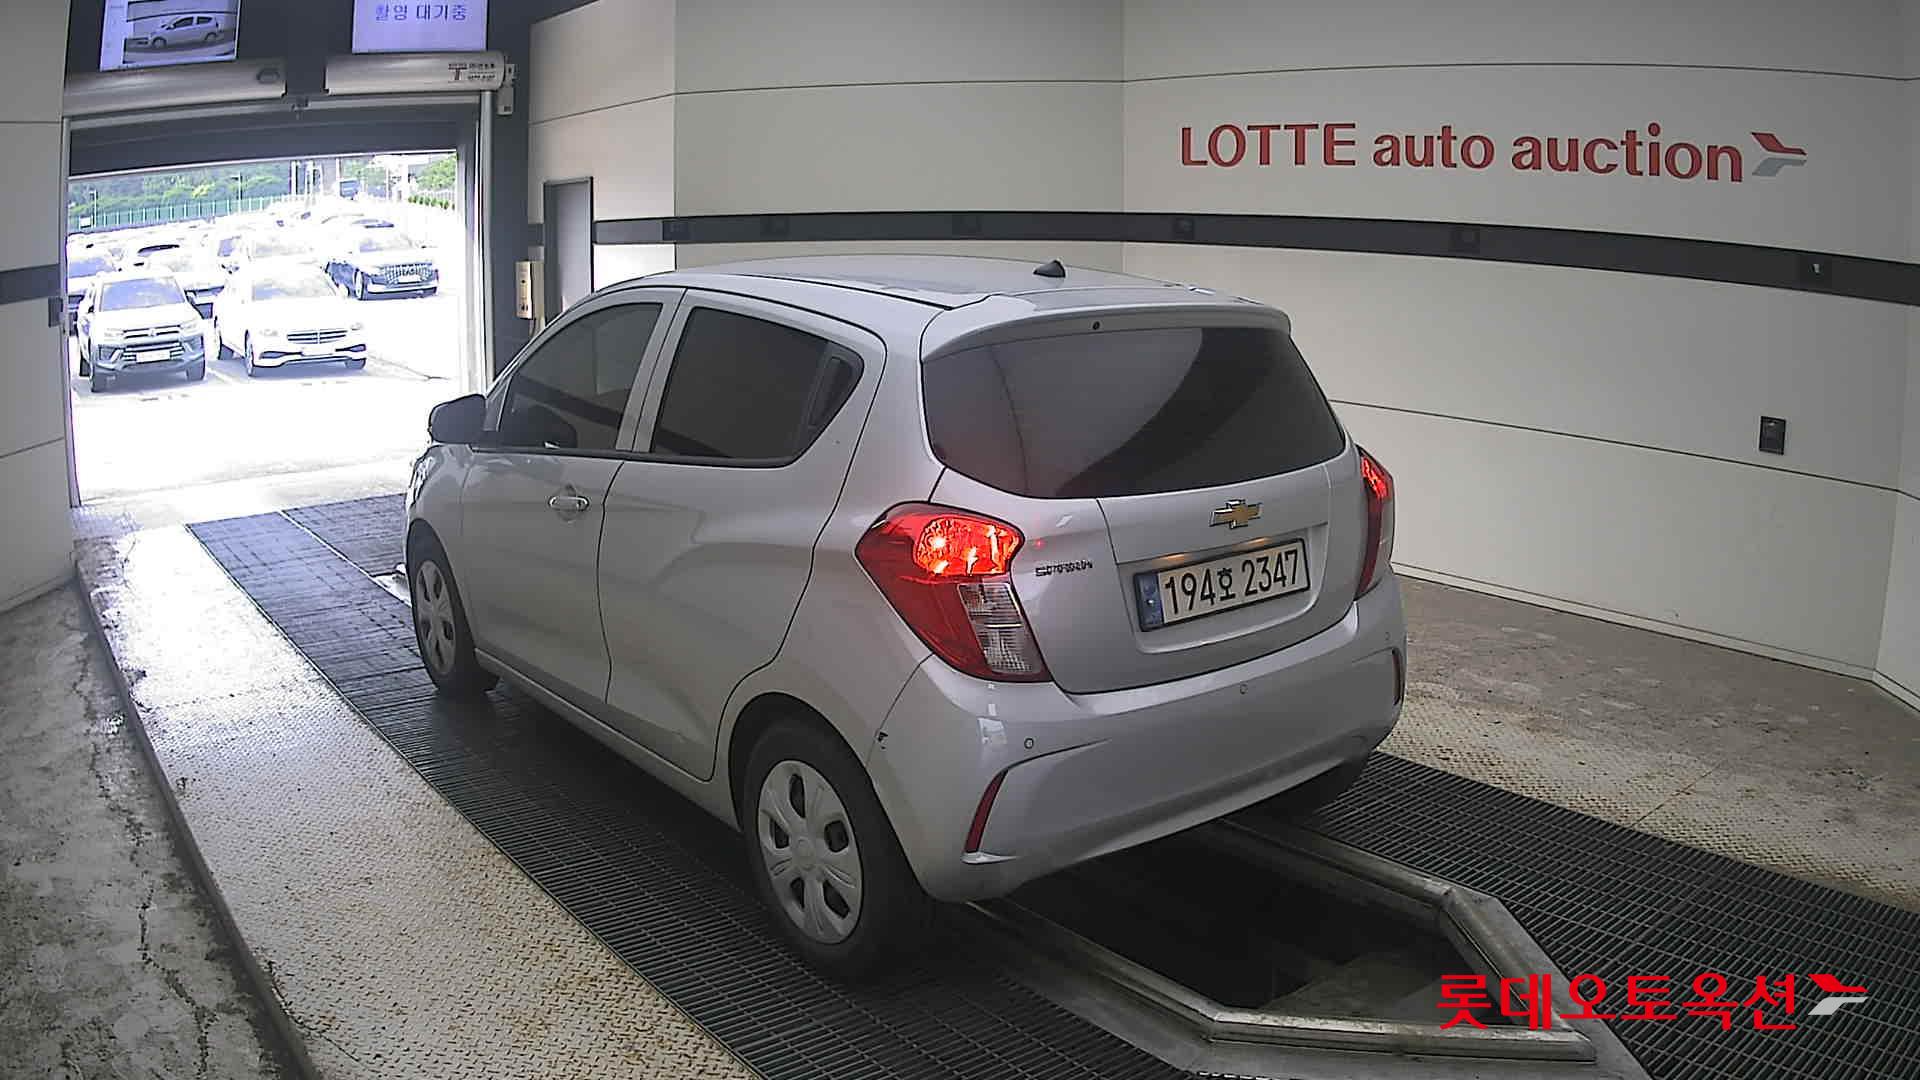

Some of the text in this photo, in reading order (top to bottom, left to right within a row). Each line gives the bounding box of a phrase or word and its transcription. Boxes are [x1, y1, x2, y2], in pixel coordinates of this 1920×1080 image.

[1181, 122, 1744, 183] LOTTE auto auction
[1164, 548, 1299, 615] 194호 2347
